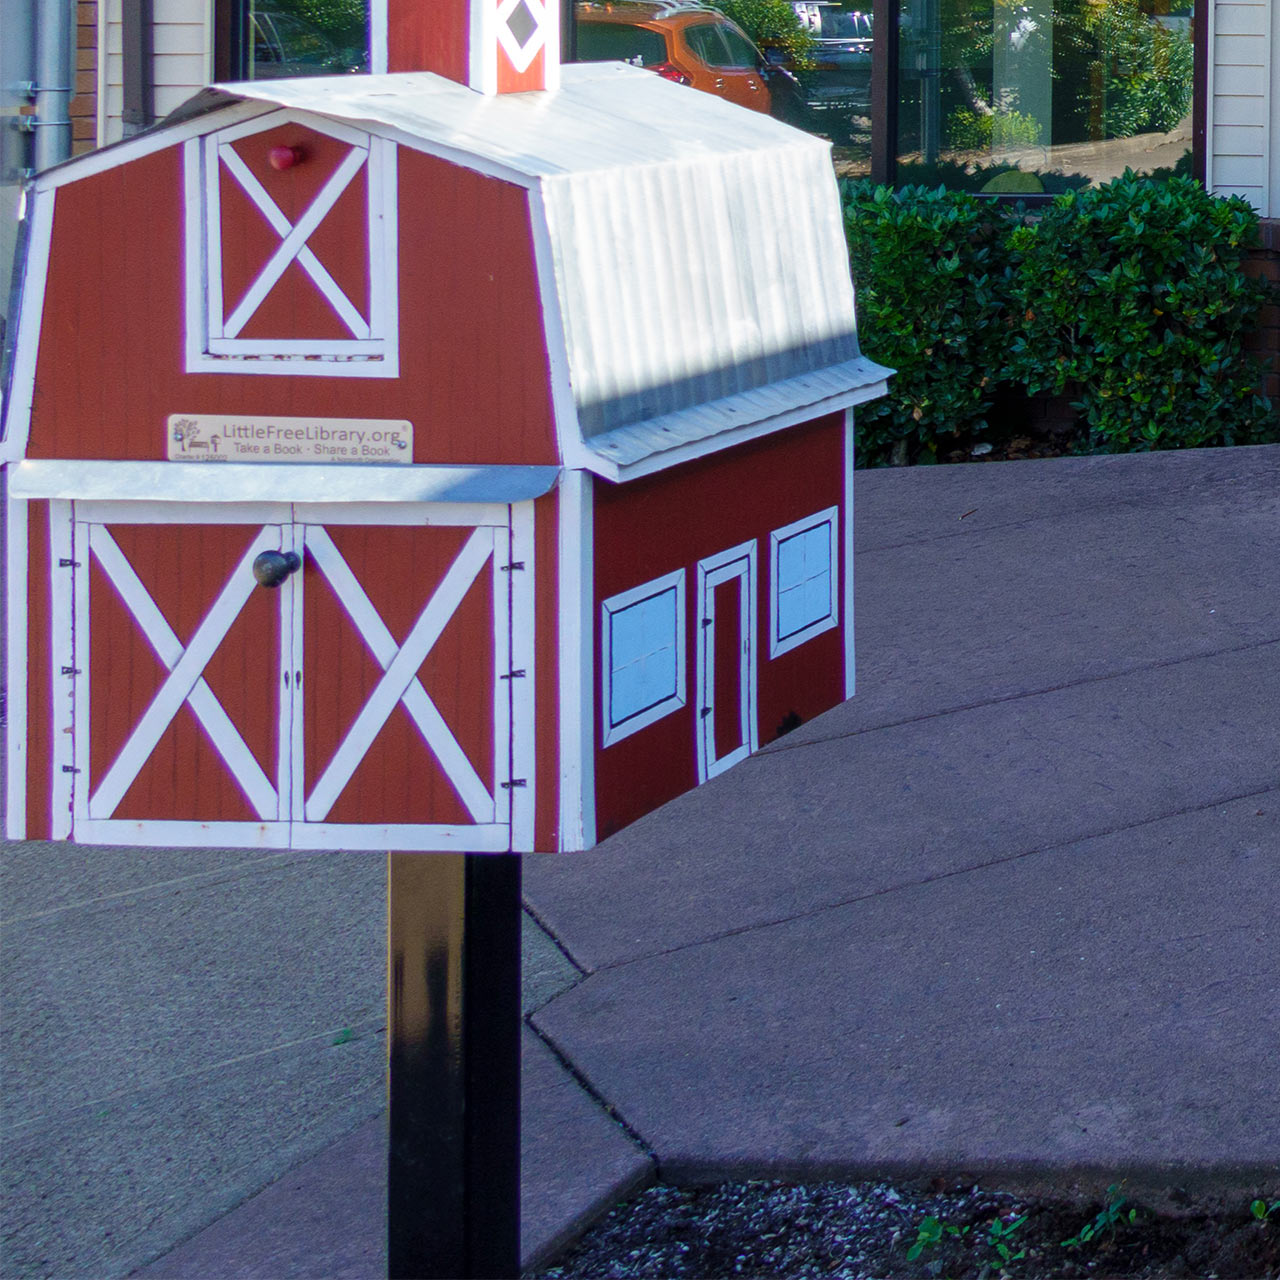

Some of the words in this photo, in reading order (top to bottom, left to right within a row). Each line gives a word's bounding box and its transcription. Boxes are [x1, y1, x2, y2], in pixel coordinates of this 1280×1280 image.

[224, 424, 400, 445] LittleFreeLibrary.org
[234, 443, 260, 454] Take
[263, 445, 270, 454] a
[274, 444, 302, 455] Book
[314, 444, 347, 456] Share
[351, 447, 358, 456] a
[362, 445, 390, 456] Book
